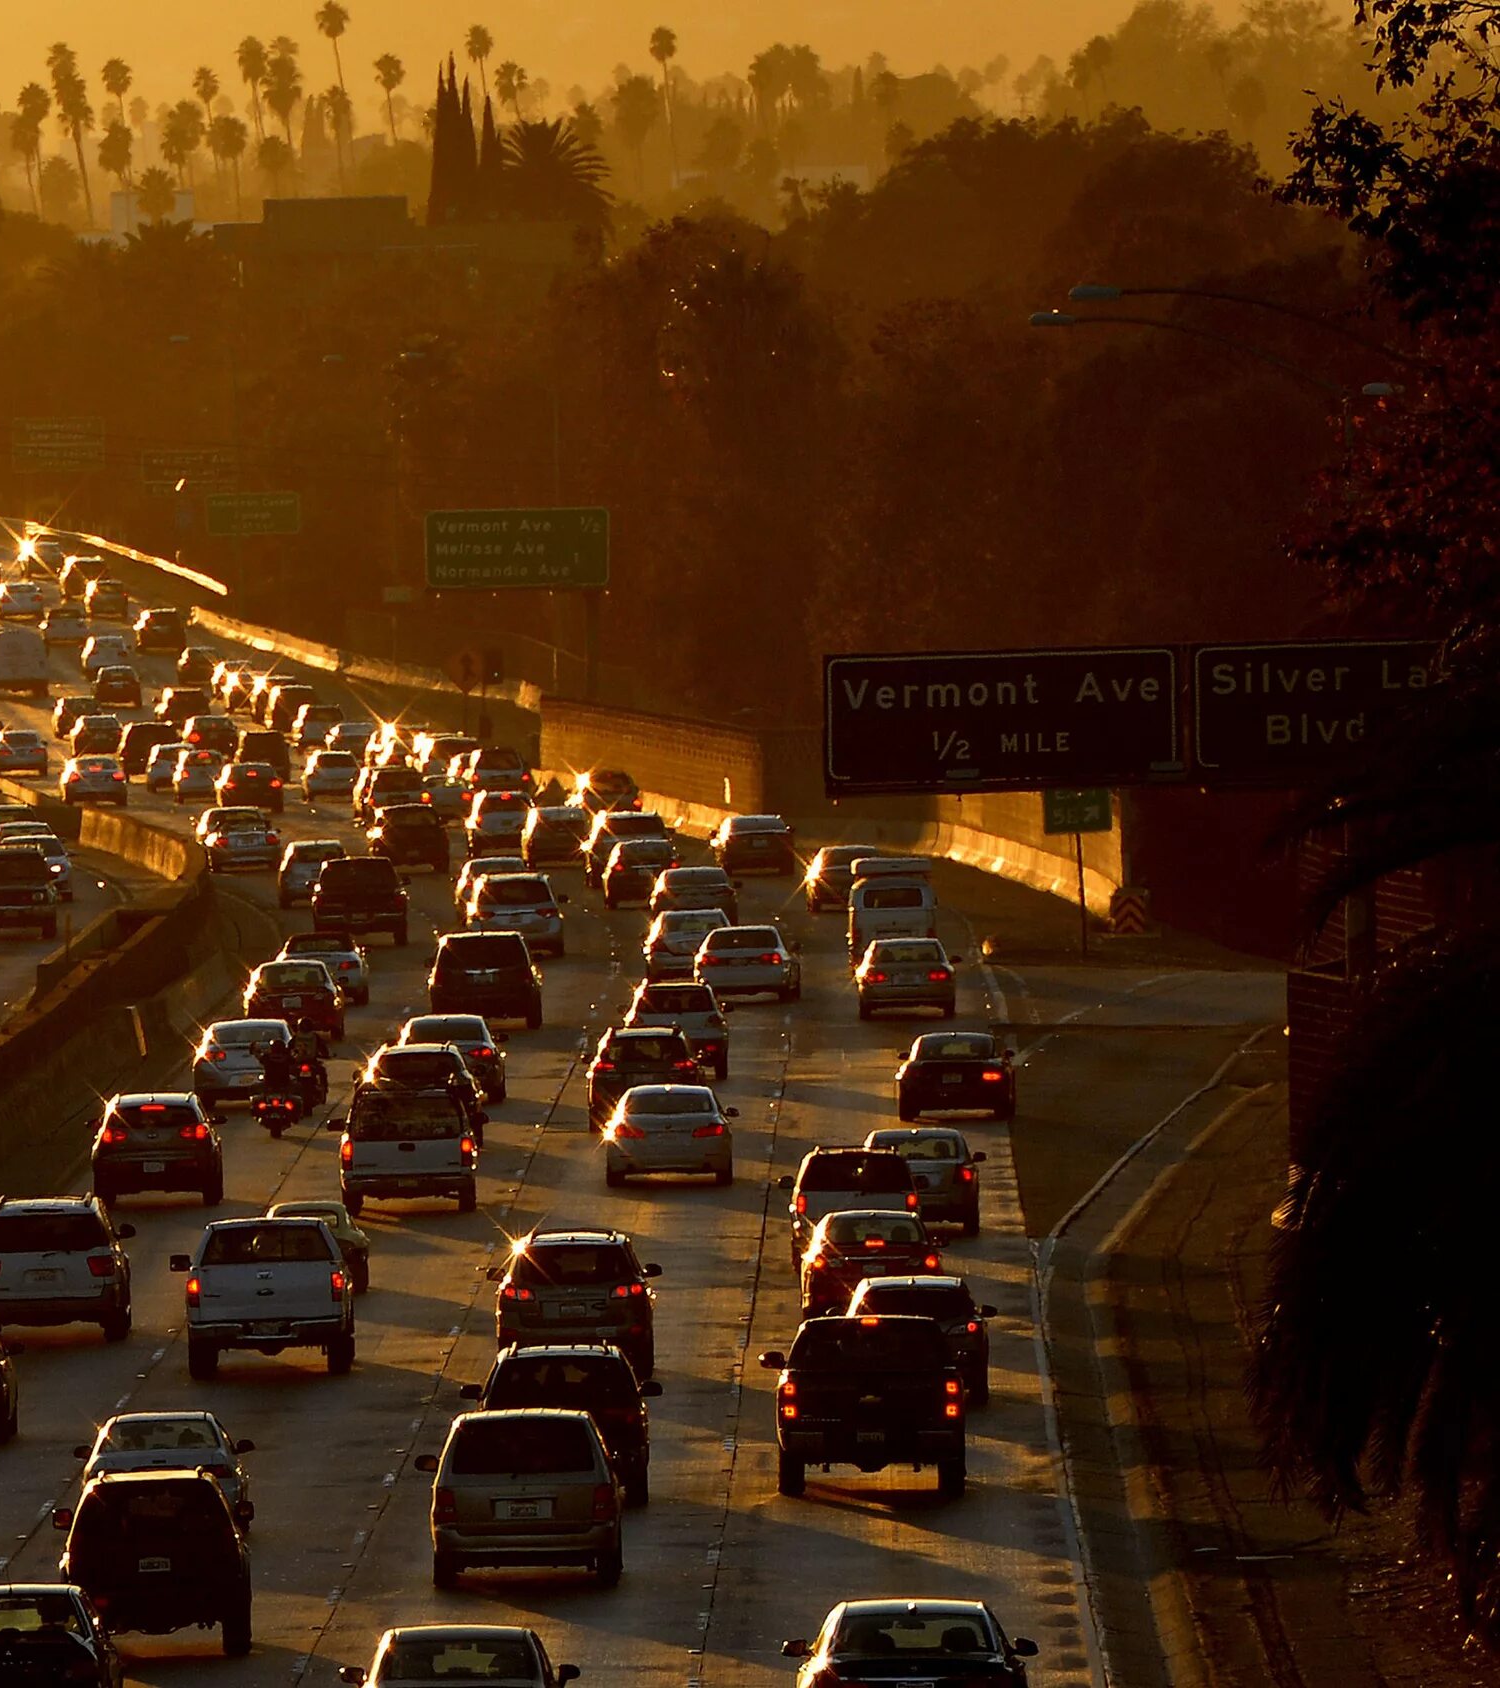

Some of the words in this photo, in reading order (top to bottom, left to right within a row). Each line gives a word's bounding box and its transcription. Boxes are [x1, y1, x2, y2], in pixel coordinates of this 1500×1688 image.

[435, 519, 509, 535] Vermont
[518, 519, 552, 532] Ave
[434, 541, 503, 556] Melrose
[512, 541, 546, 556] Ave
[435, 563, 529, 579] Normandie
[538, 563, 571, 577] Ave
[842, 674, 1039, 711] Vermont
[1074, 671, 1161, 704] Ave
[1211, 661, 1352, 695] Silver
[1381, 658, 1429, 689] La
[1265, 712, 1365, 745] Blvd
[932, 730, 971, 761] 1/2
[999, 731, 1071, 754] MILE
